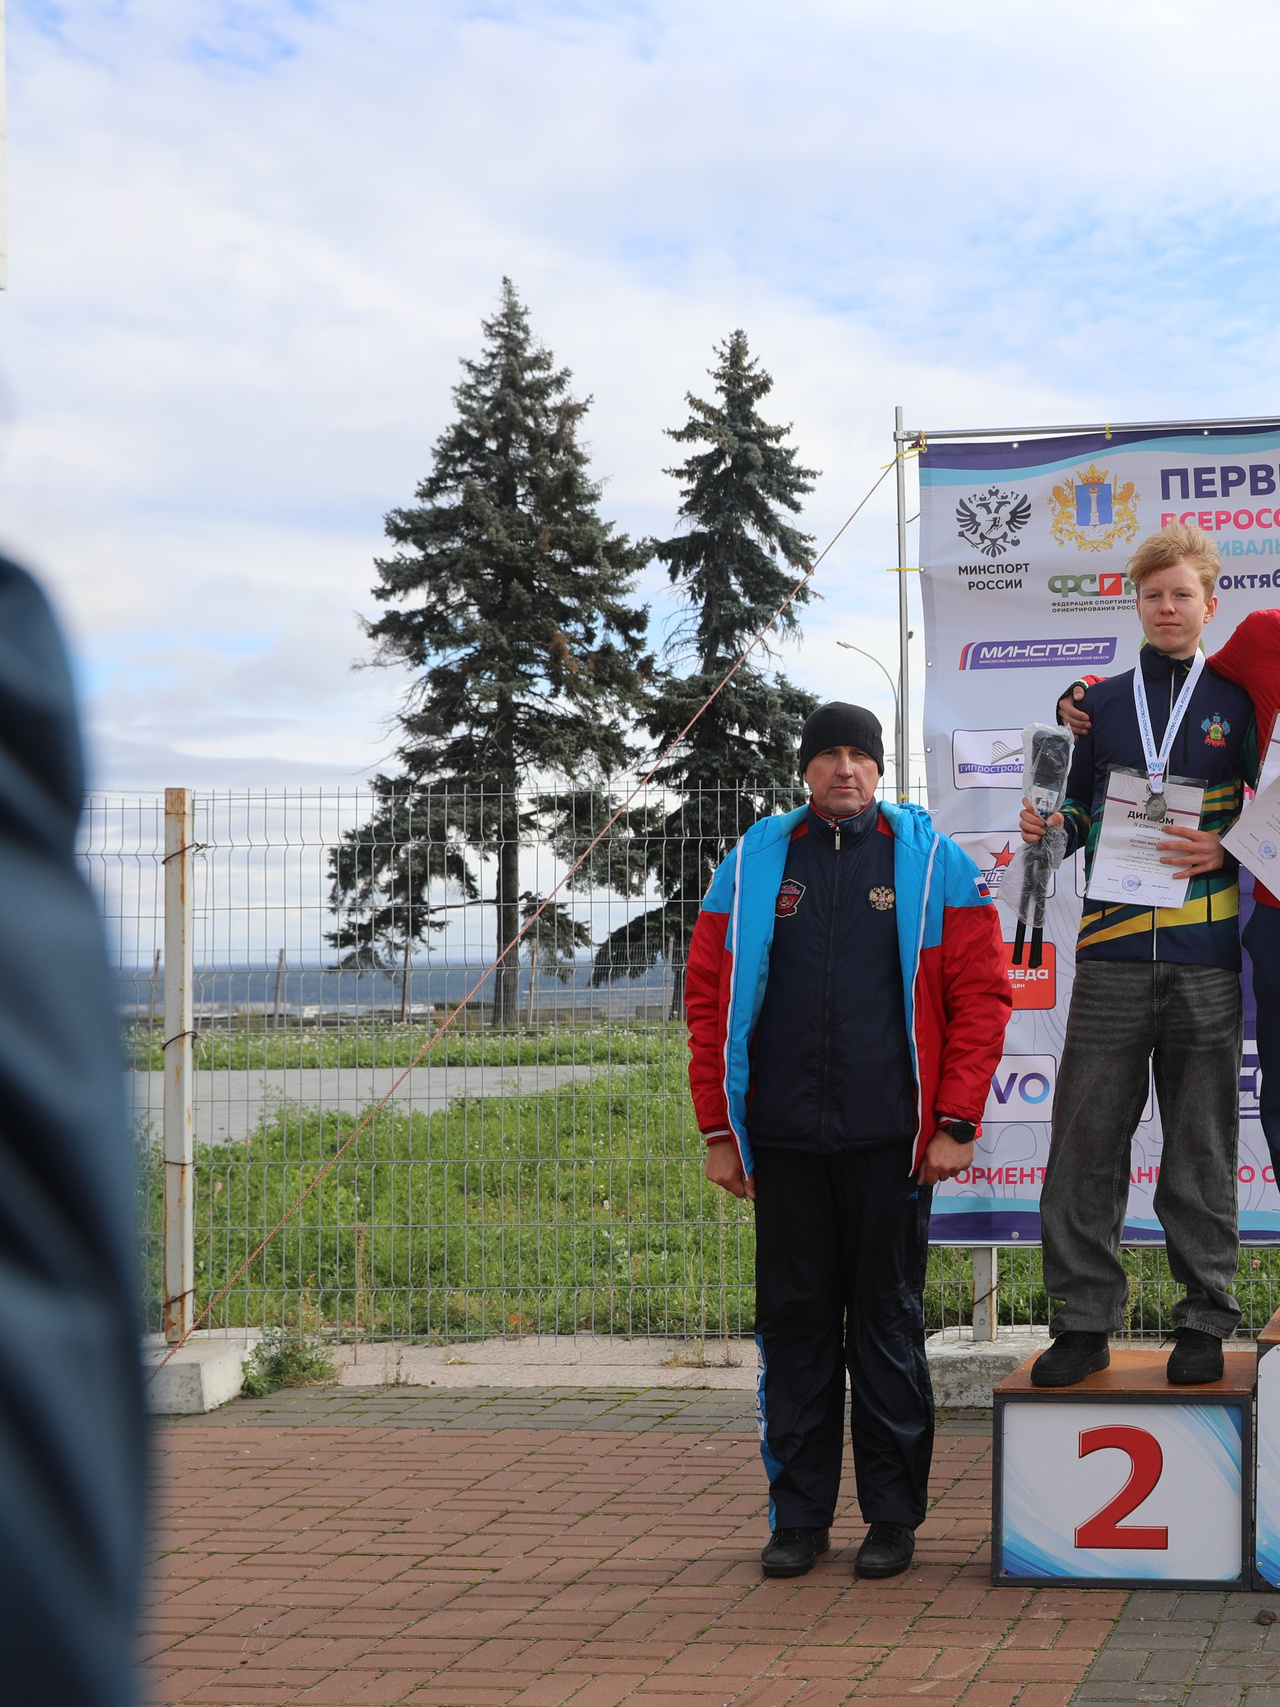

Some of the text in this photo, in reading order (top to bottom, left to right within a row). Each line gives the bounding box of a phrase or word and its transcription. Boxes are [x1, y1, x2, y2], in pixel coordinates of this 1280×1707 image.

[958, 563, 1030, 576] МИНСПОРТ
[968, 579, 1023, 591] РОССИИ
[1051, 605, 1116, 613] ОРИЕНТИРОВАНИЯ
[980, 642, 1110, 659] МИНСПОРТ
[1074, 1424, 1169, 1550] 2
